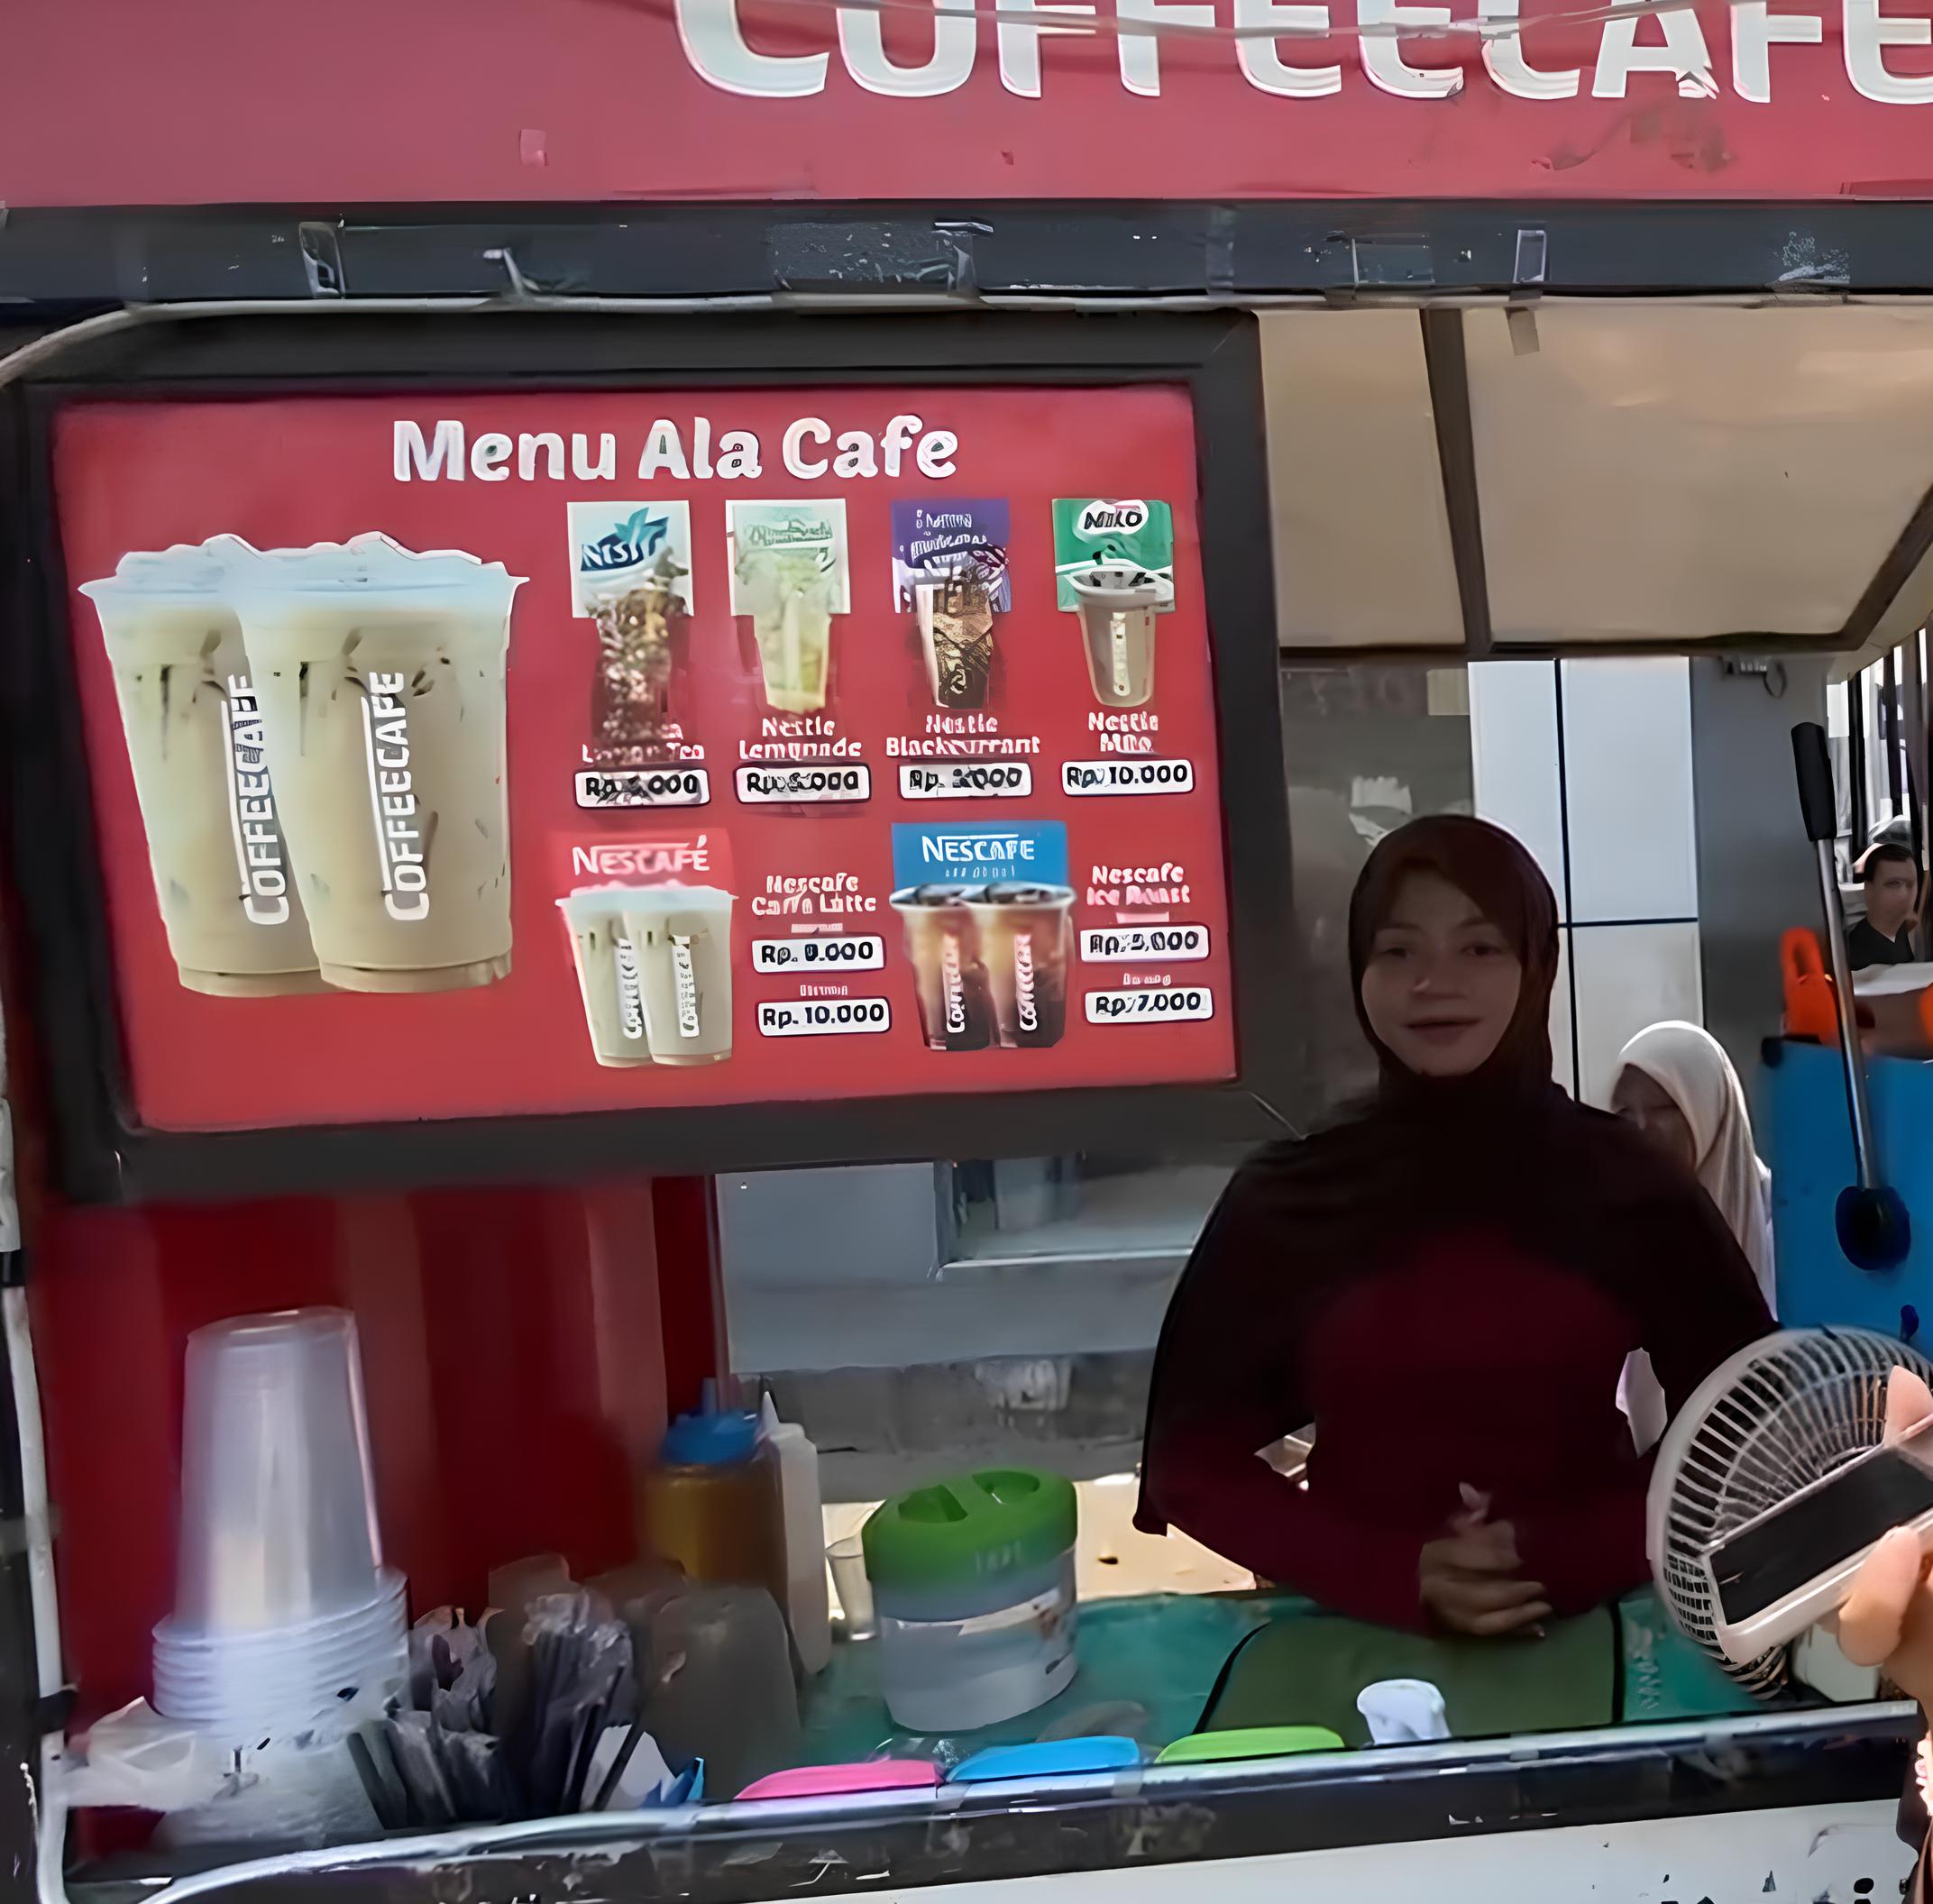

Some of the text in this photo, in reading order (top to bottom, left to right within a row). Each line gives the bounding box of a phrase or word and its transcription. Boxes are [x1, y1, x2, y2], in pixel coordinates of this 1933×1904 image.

[393, 414, 959, 481] Menu Ala Cafe
[1109, 764, 1187, 784] 10.000
[362, 672, 429, 921] COFFEECAFE
[805, 1003, 884, 1024] 10.000
